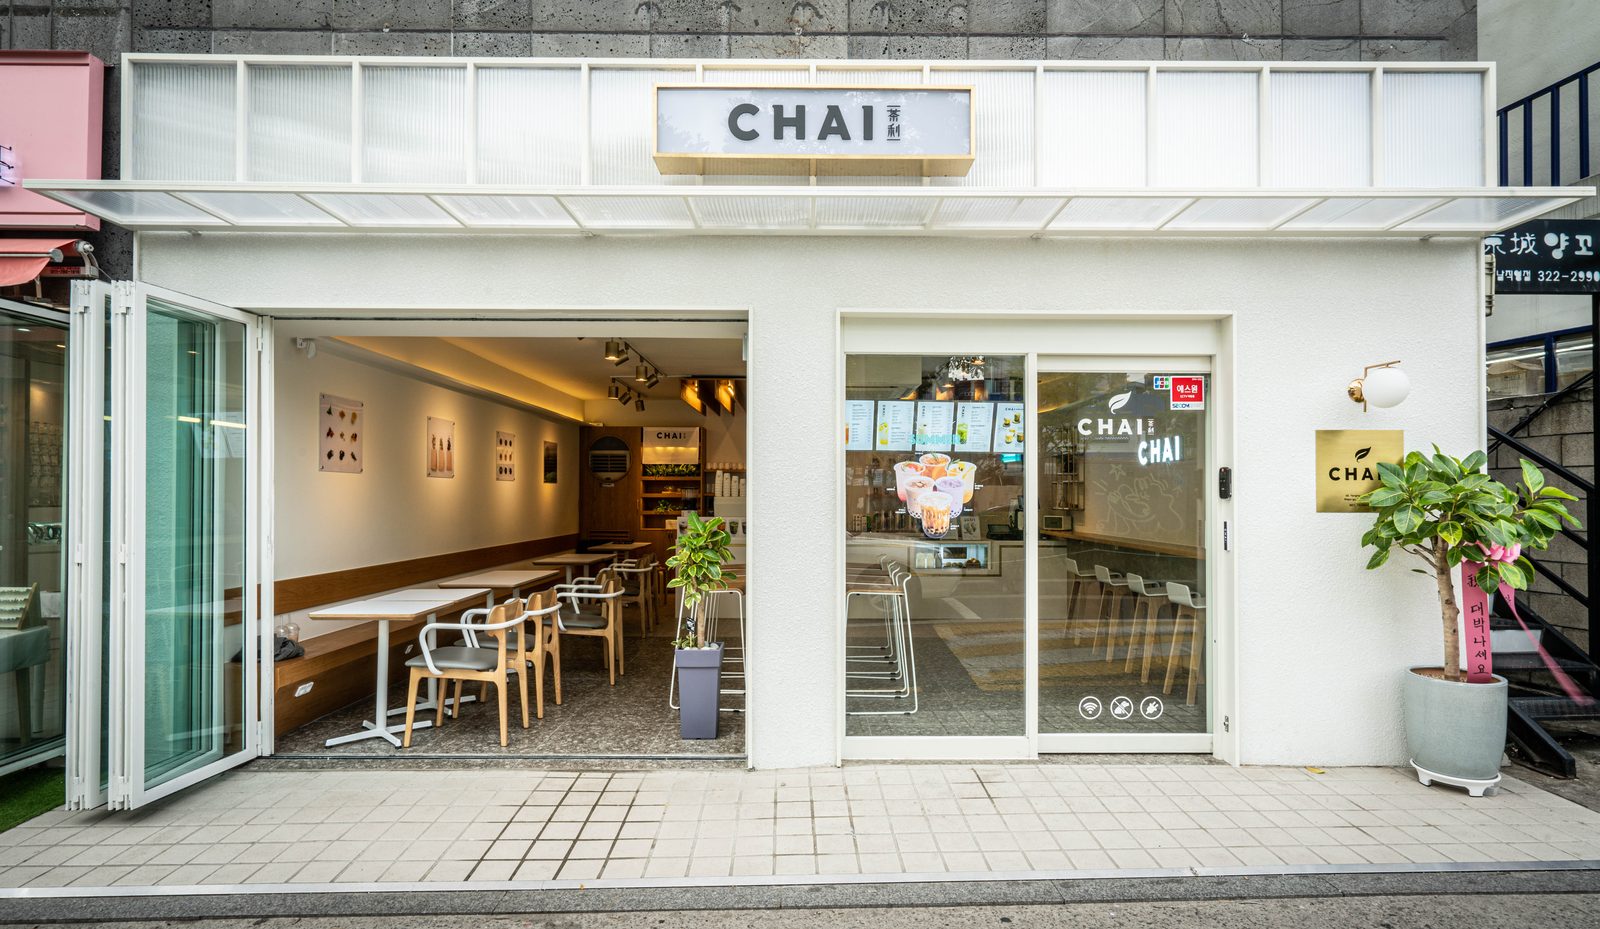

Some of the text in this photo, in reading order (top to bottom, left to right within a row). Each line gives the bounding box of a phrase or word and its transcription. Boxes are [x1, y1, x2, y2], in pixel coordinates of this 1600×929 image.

[728, 103, 873, 141] CHAI
[887, 108, 900, 138] 茶利
[1537, 270, 1600, 282] 322-2990
[1176, 385, 1198, 393] 에스원
[1077, 418, 1143, 436] CHAI
[1138, 435, 1181, 466] CHAI
[1470, 601, 1489, 675] 대박나세요
